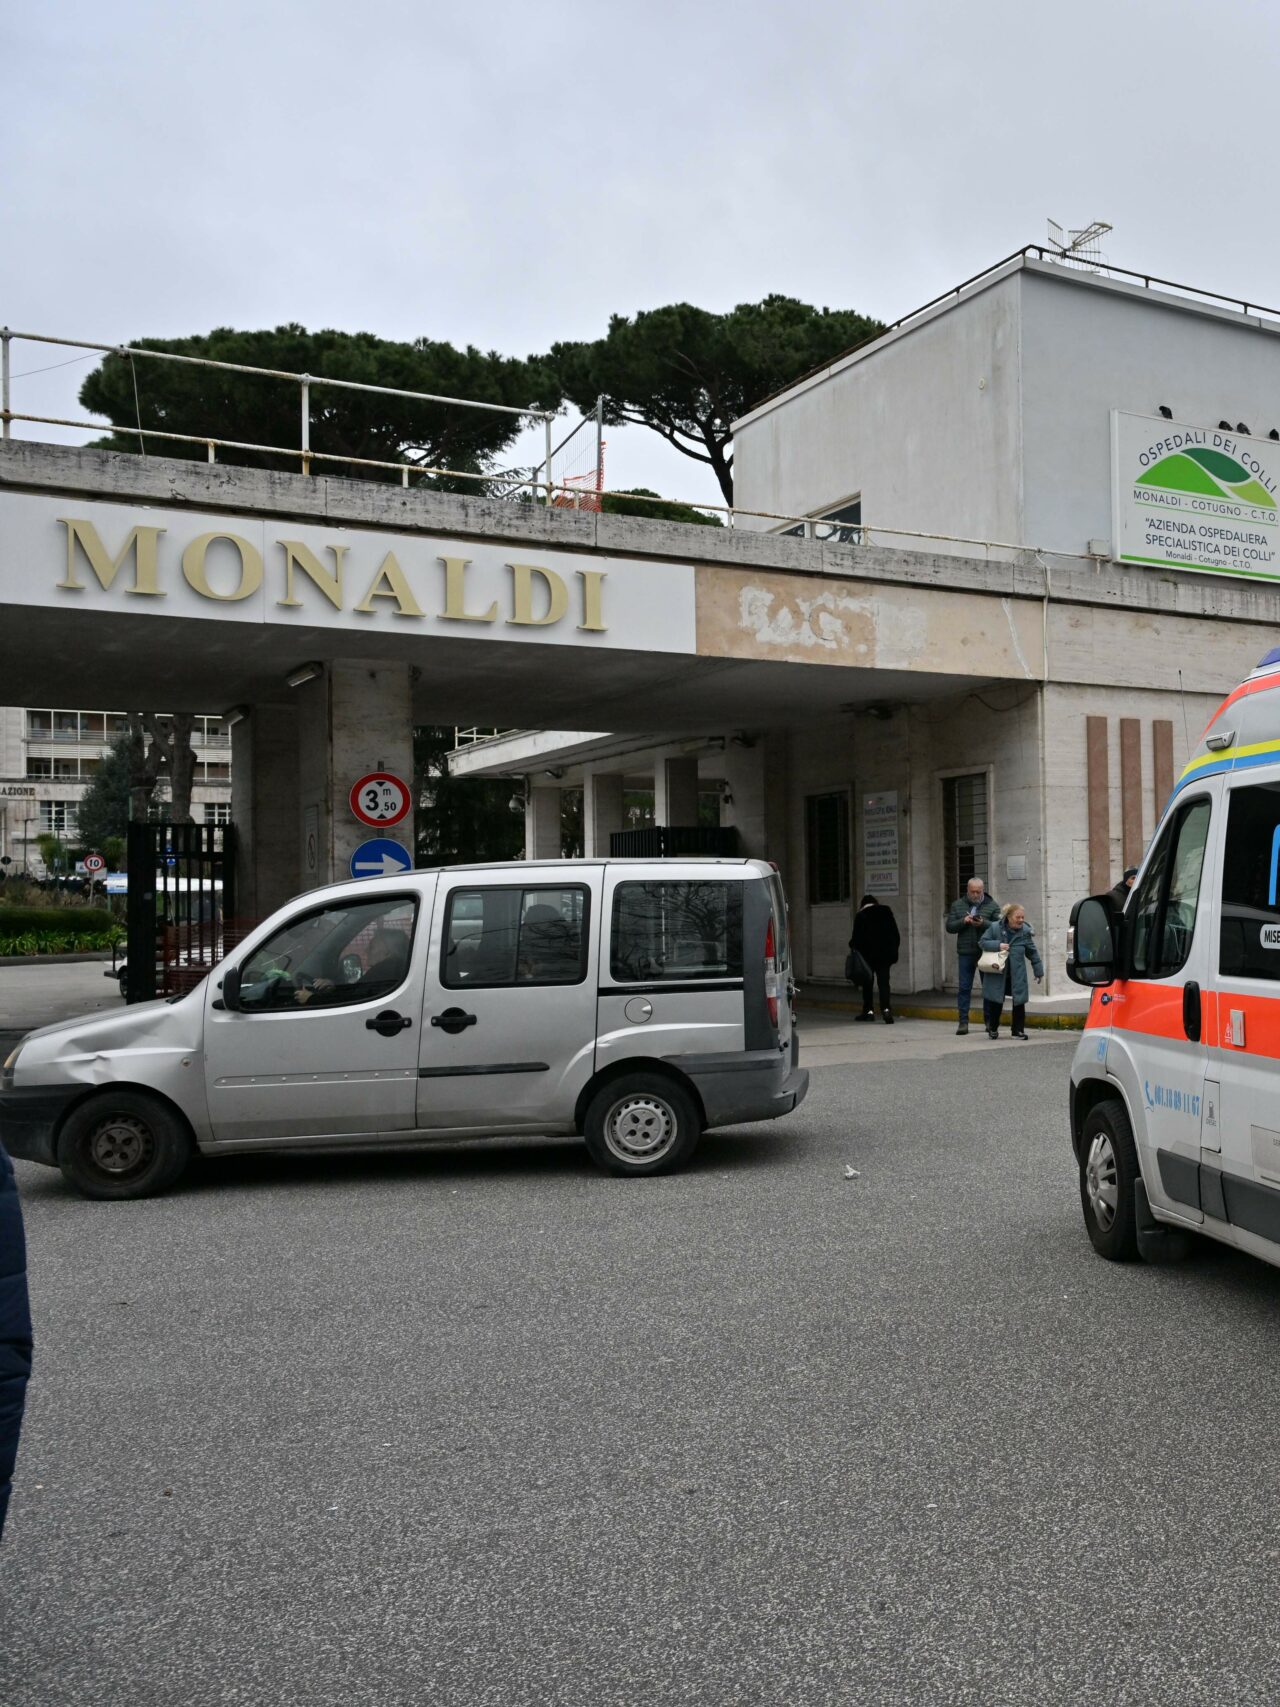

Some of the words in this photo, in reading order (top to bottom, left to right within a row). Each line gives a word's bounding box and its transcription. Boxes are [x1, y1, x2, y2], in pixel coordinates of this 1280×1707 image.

[1139, 432, 1206, 466] OSPEDALI
[1213, 434, 1237, 455] DEI
[1241, 452, 1277, 493] COLLI
[1133, 490, 1181, 506] MONALDI
[1192, 500, 1241, 516] COTUGNO
[1251, 509, 1279, 522] C.T.O.
[1145, 533, 1221, 555] SPECIALISTICA
[1223, 545, 1240, 557] DEI
[1199, 526, 1268, 546] OSPEDALIERA
[1165, 551, 1193, 561] Monaldi
[1198, 555, 1227, 567] Cotugno
[1232, 559, 1252, 569] C.T.O.
[56, 517, 608, 632] MONALDI
[0, 787, 35, 796] AZIONE
[89, 859, 100, 868] 10
